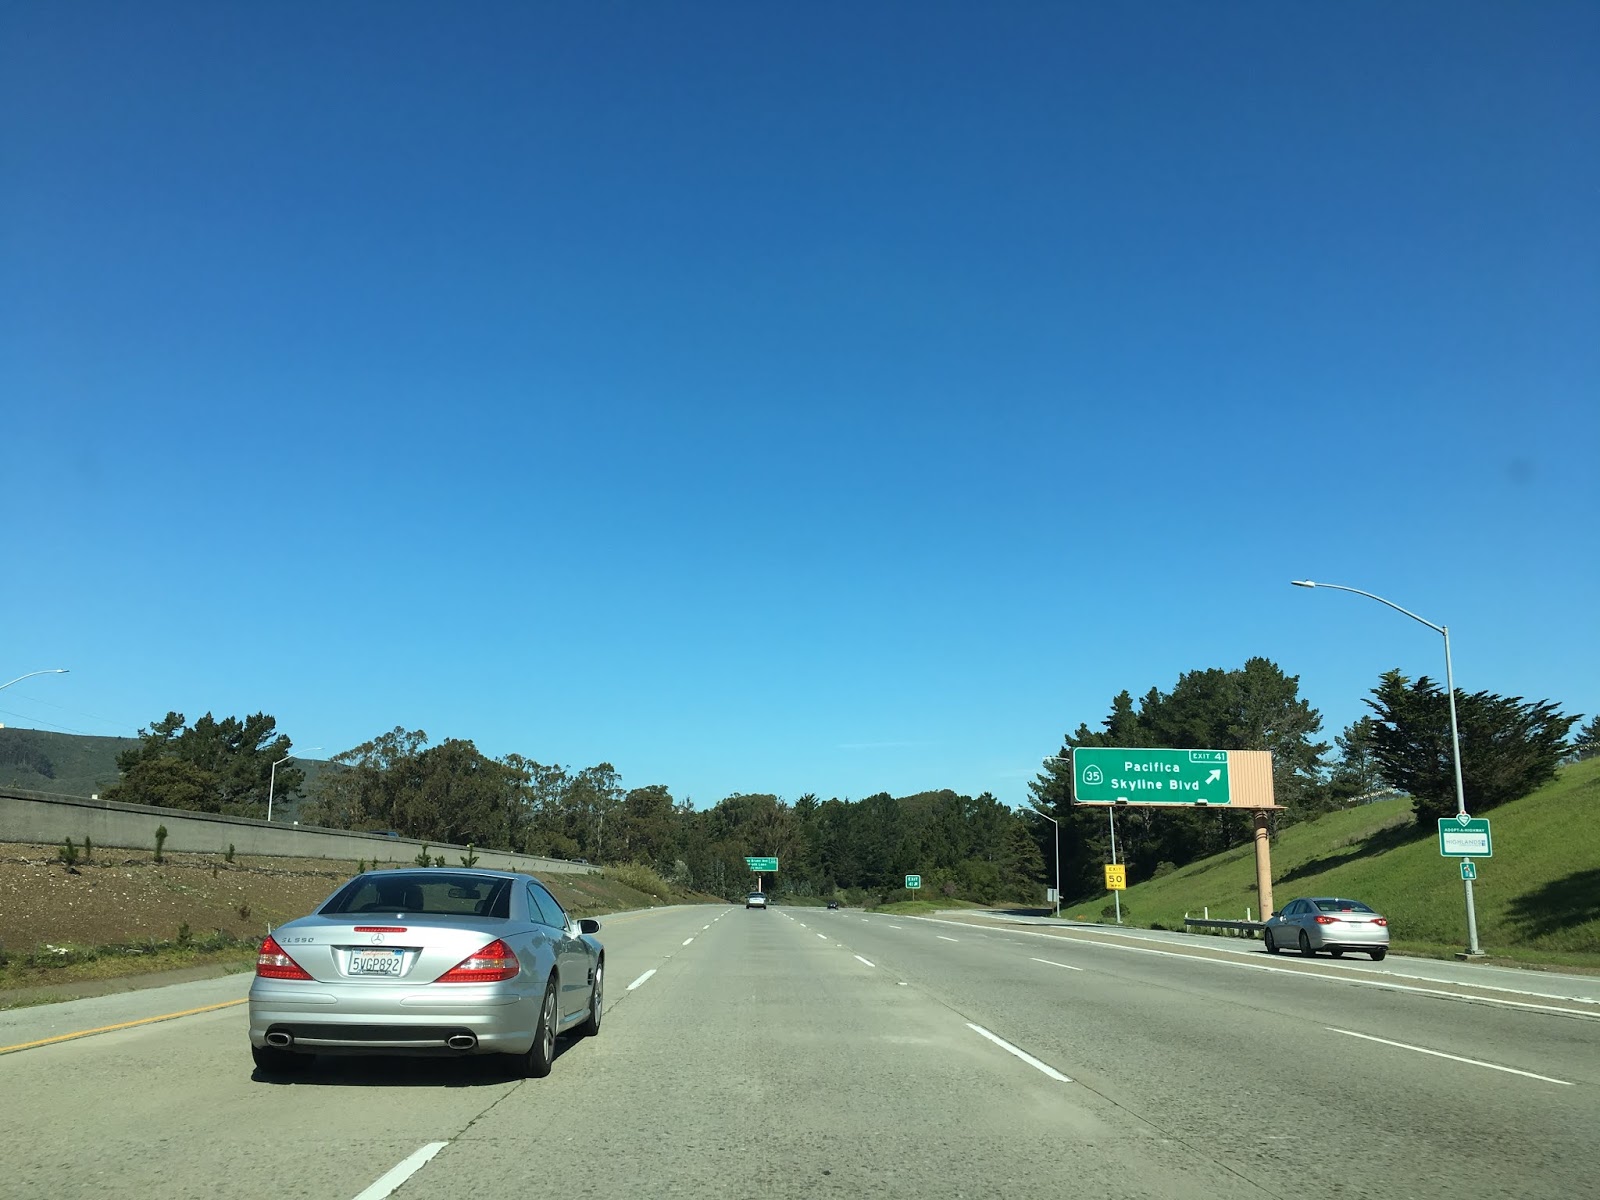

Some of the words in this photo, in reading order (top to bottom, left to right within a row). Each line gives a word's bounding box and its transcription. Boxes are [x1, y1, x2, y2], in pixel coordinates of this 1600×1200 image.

[1124, 762, 1180, 773] Pacifica
[1086, 771, 1100, 781] 35
[1111, 779, 1163, 792] Skyline
[1169, 780, 1200, 791] Blvd
[1108, 875, 1122, 883] 50
[353, 957, 400, 972] 5VGP892
